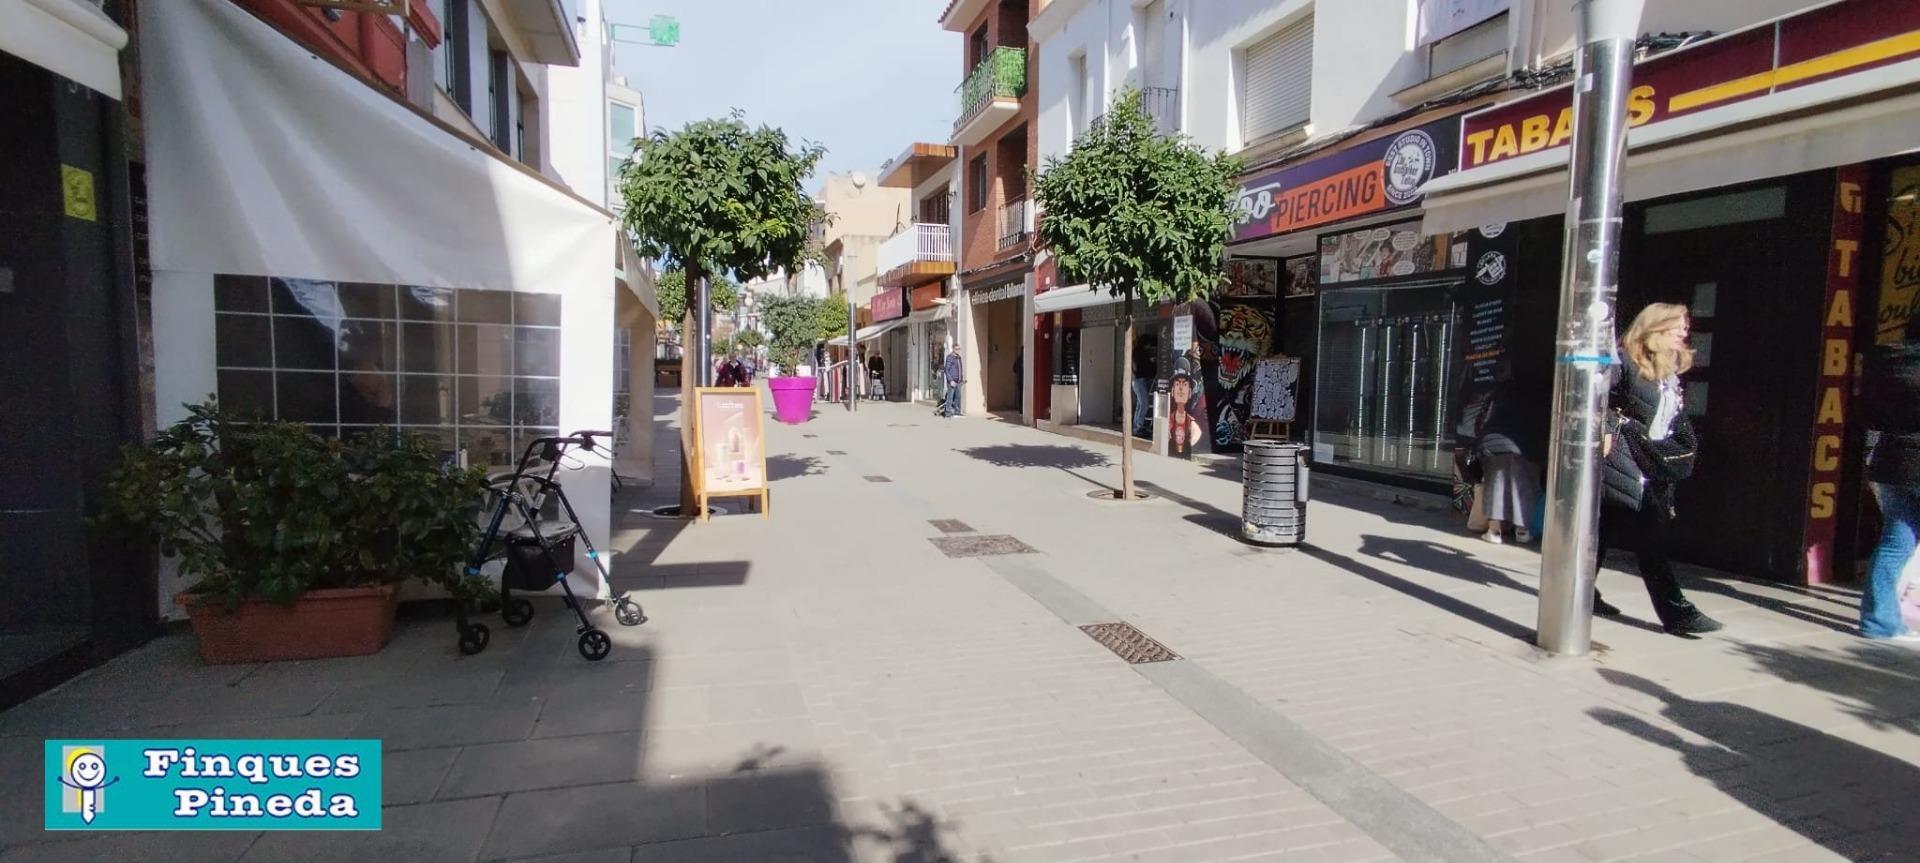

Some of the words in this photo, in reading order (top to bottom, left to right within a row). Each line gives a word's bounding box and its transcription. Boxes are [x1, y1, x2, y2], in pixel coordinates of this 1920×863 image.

[1467, 86, 1655, 165] TABAS
[1275, 170, 1378, 229] PIERCING
[1810, 239, 1858, 519] TABACS
